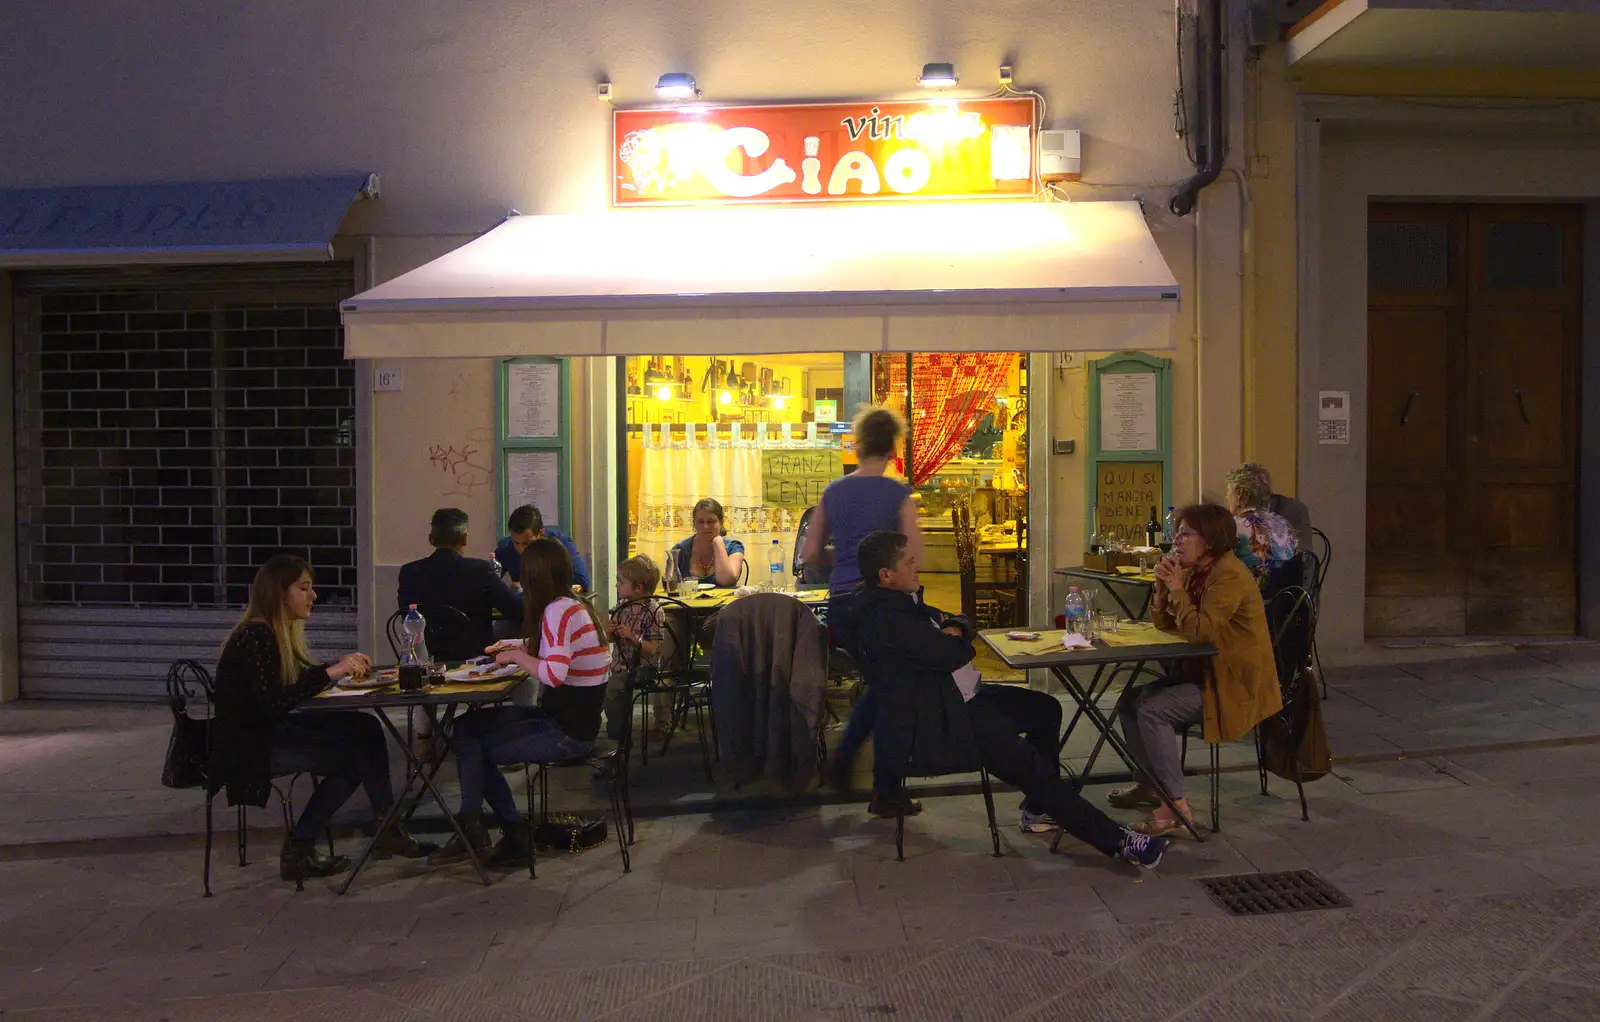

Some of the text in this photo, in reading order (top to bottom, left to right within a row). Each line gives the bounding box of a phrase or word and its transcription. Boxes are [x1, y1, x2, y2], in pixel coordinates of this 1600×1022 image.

[1104, 469, 1135, 485] QUI
[765, 479, 829, 505] LENT
[1103, 489, 1154, 503] MANGIA
[1105, 504, 1146, 518] BENE
